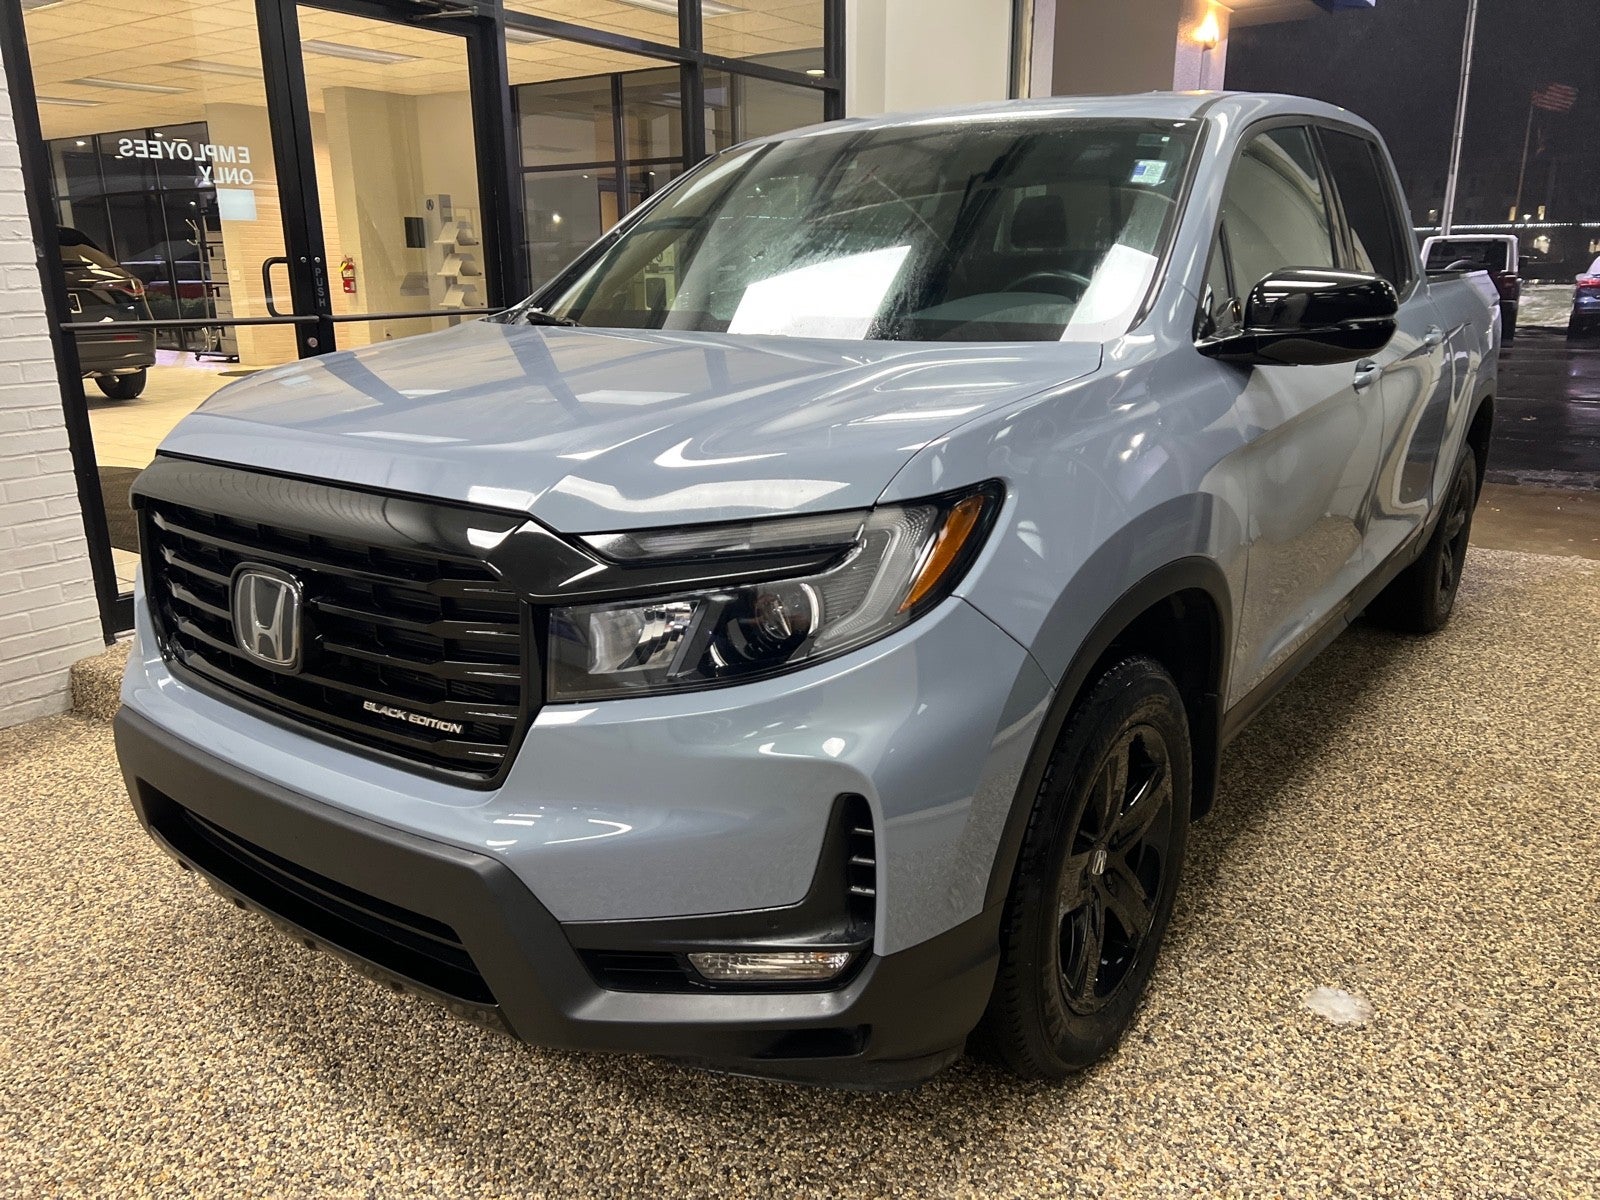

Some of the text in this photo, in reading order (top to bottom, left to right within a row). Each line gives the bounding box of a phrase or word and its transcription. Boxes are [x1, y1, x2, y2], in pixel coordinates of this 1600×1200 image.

[314, 267, 326, 307] PUSH
[363, 700, 463, 734] BLACK EDITION
